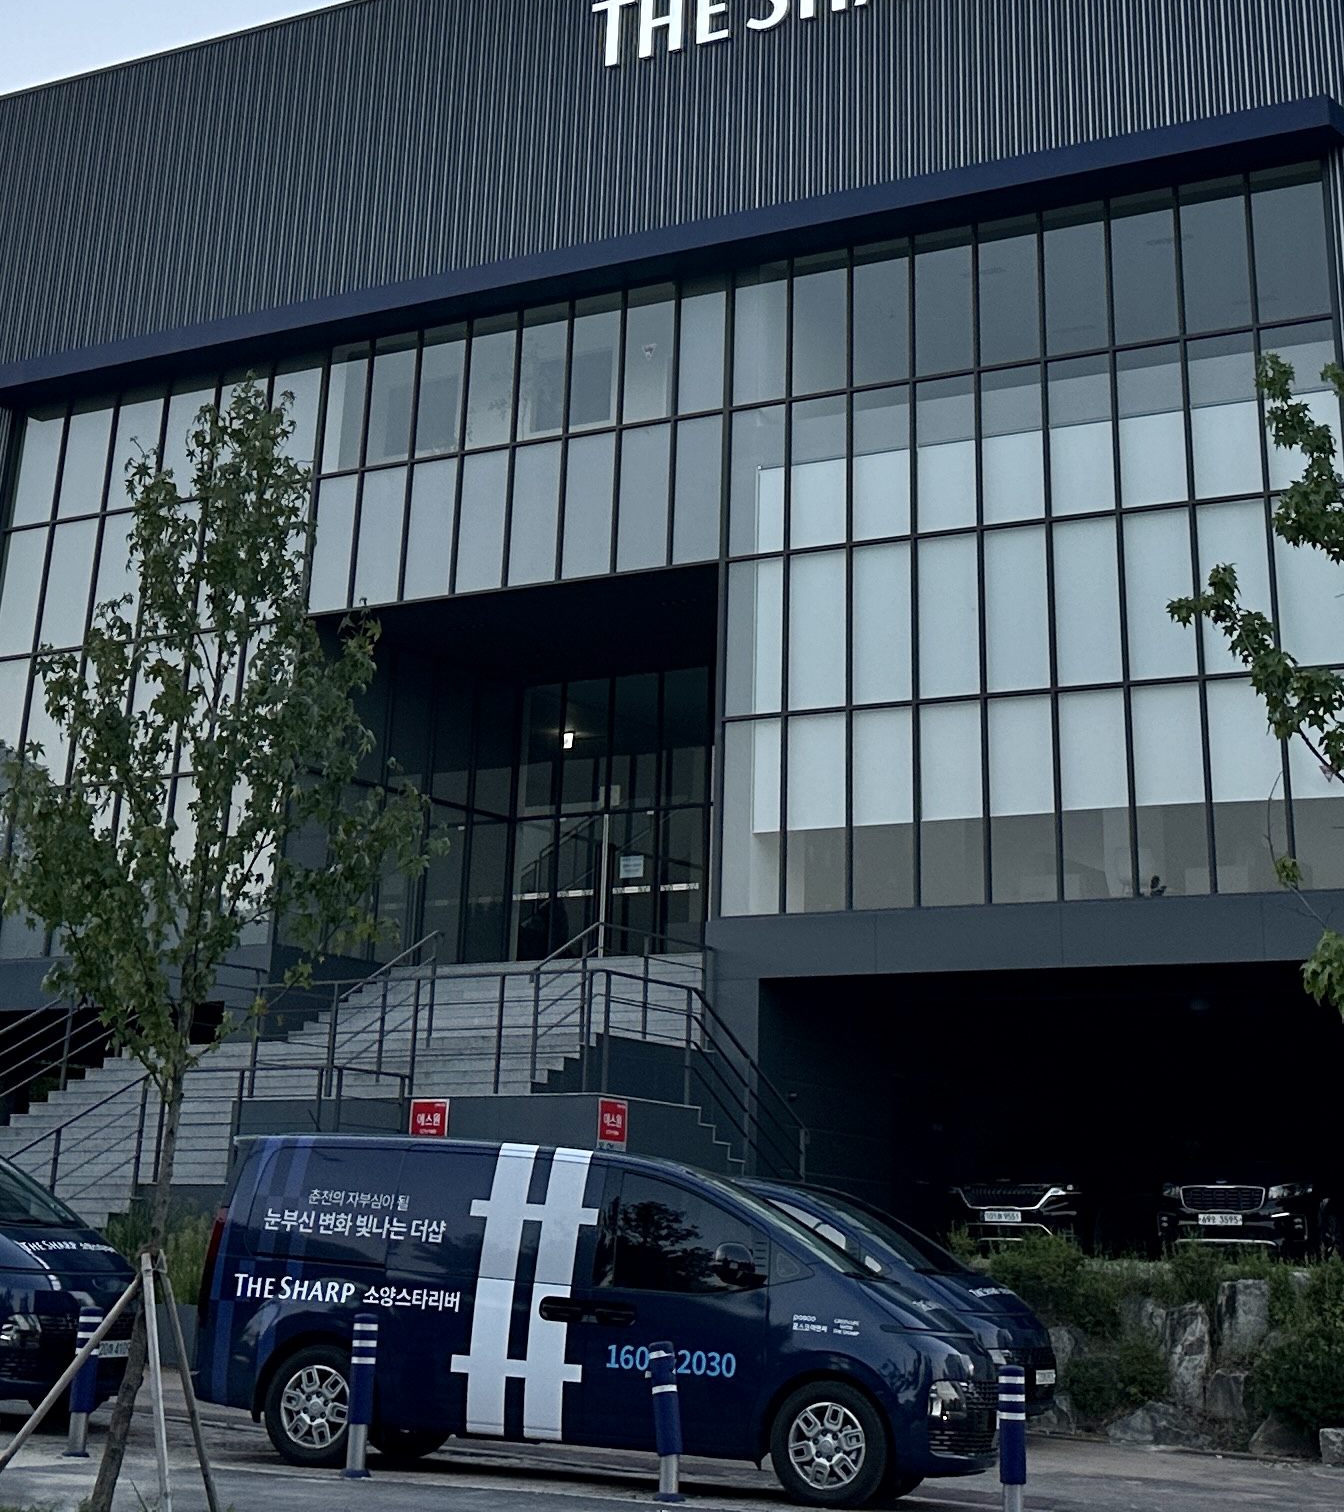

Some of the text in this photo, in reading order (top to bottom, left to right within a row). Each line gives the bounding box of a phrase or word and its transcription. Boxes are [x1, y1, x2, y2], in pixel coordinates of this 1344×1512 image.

[416, 1112, 441, 1126] 에스원
[308, 1188, 410, 1212] 춘천의 자부심이 될
[263, 1208, 447, 1243] 눈부신 변화 빛나는 더샵
[234, 1273, 461, 1313] THE SHARP 소양스타리버
